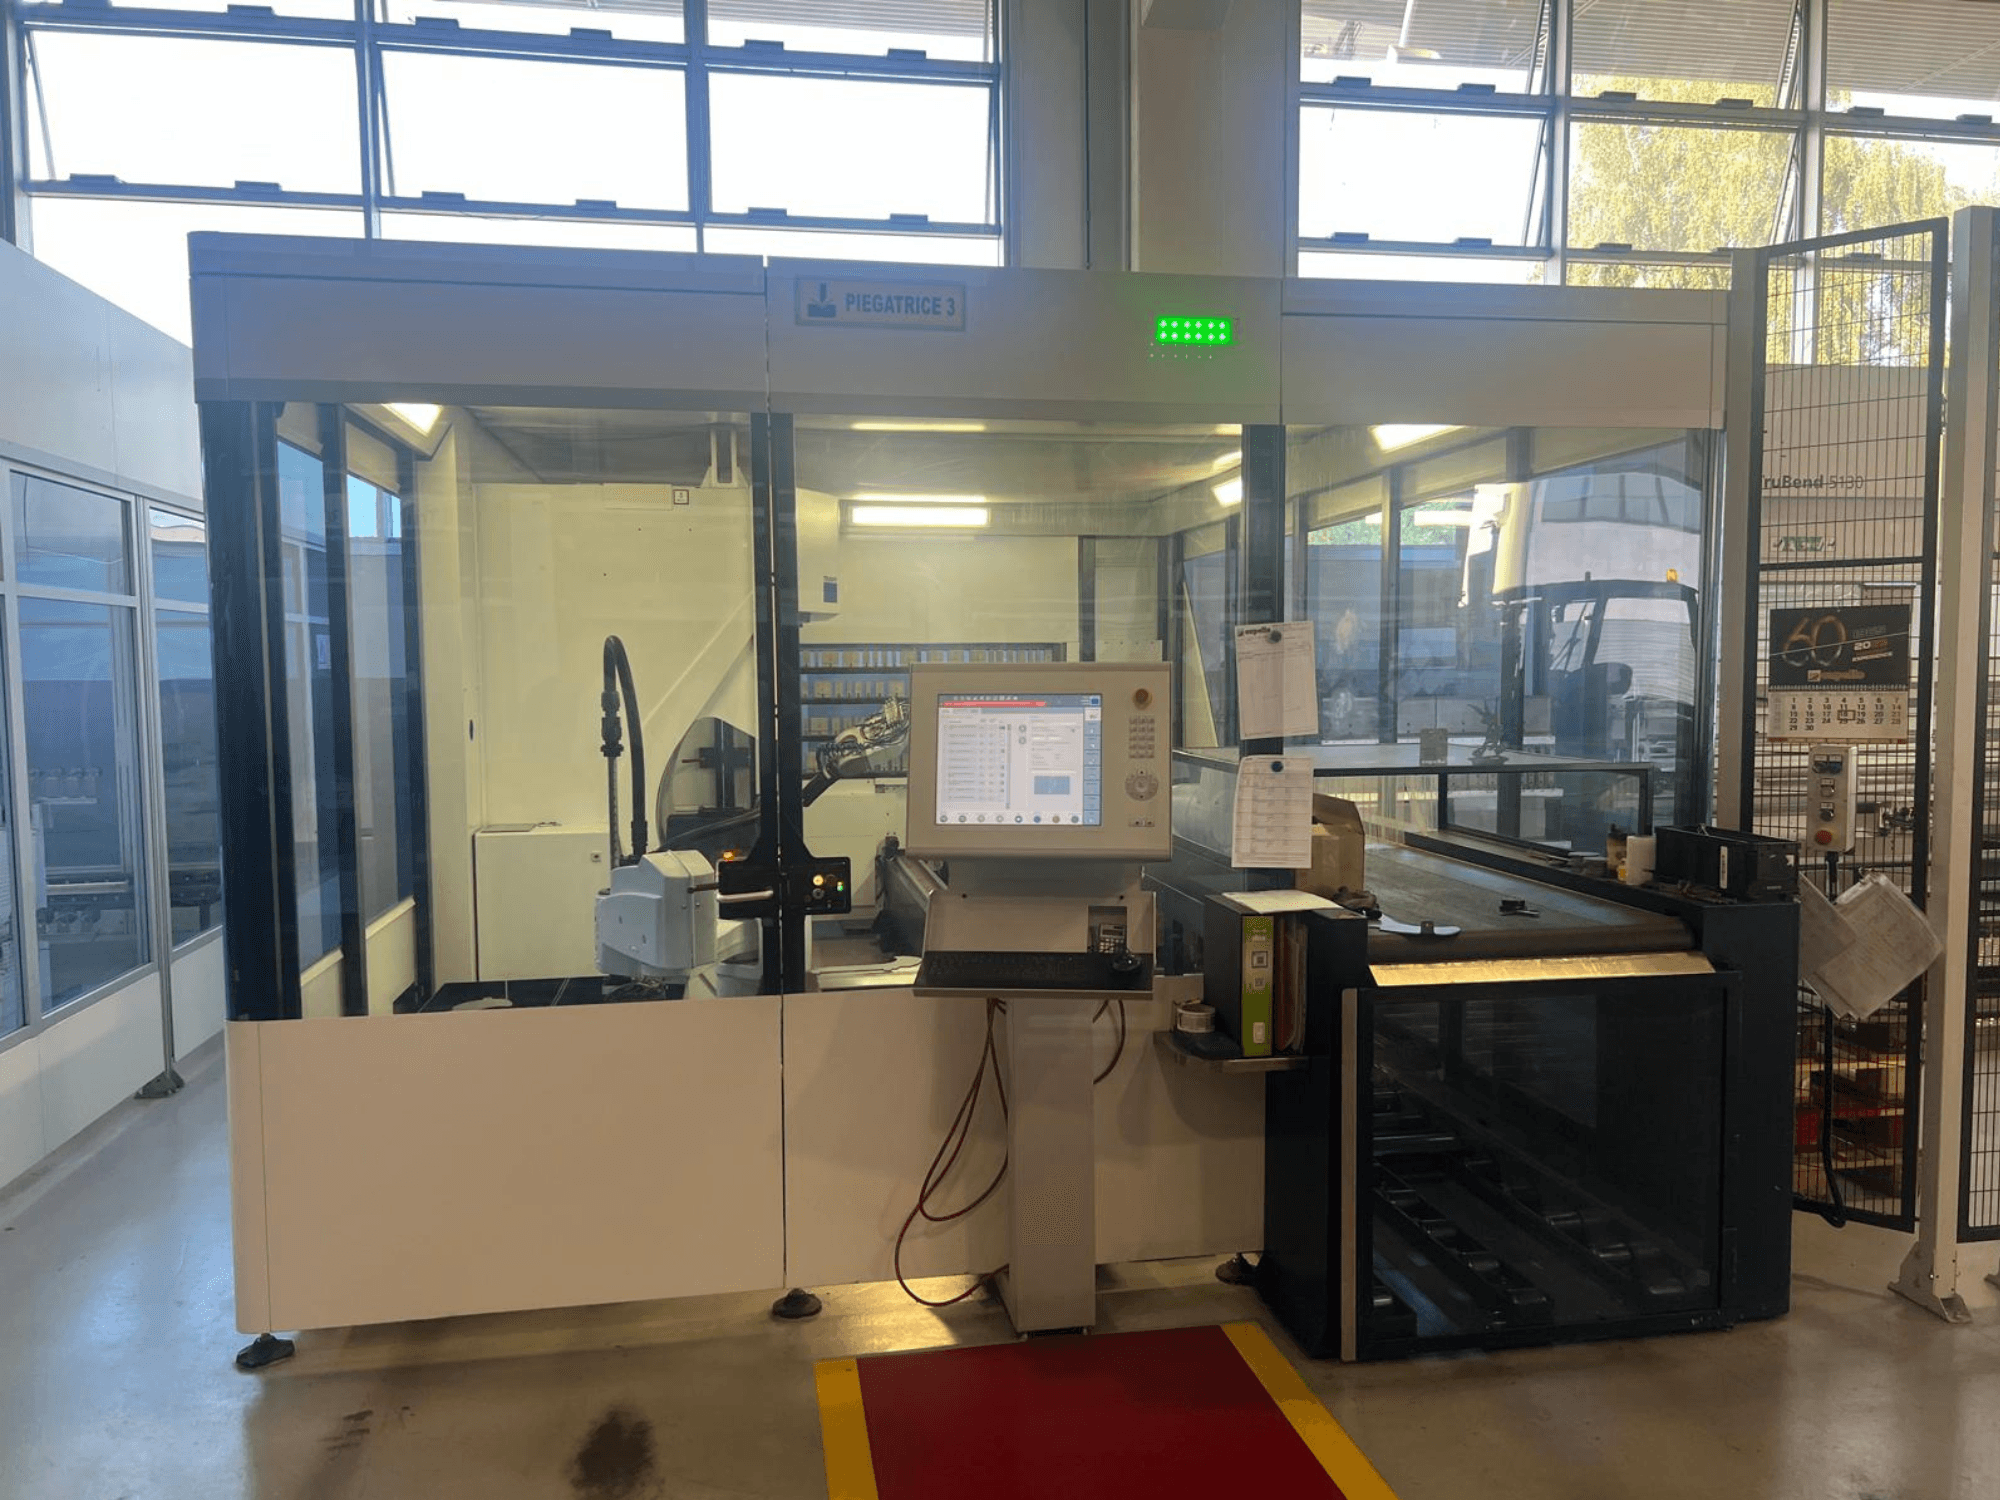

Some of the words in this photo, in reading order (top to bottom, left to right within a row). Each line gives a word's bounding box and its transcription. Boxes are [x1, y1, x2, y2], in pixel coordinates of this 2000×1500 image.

[845, 293, 942, 315] PIEGATRICE
[946, 297, 956, 317] 3
[1762, 474, 1823, 489] ruBend
[1781, 614, 1847, 667] 60
